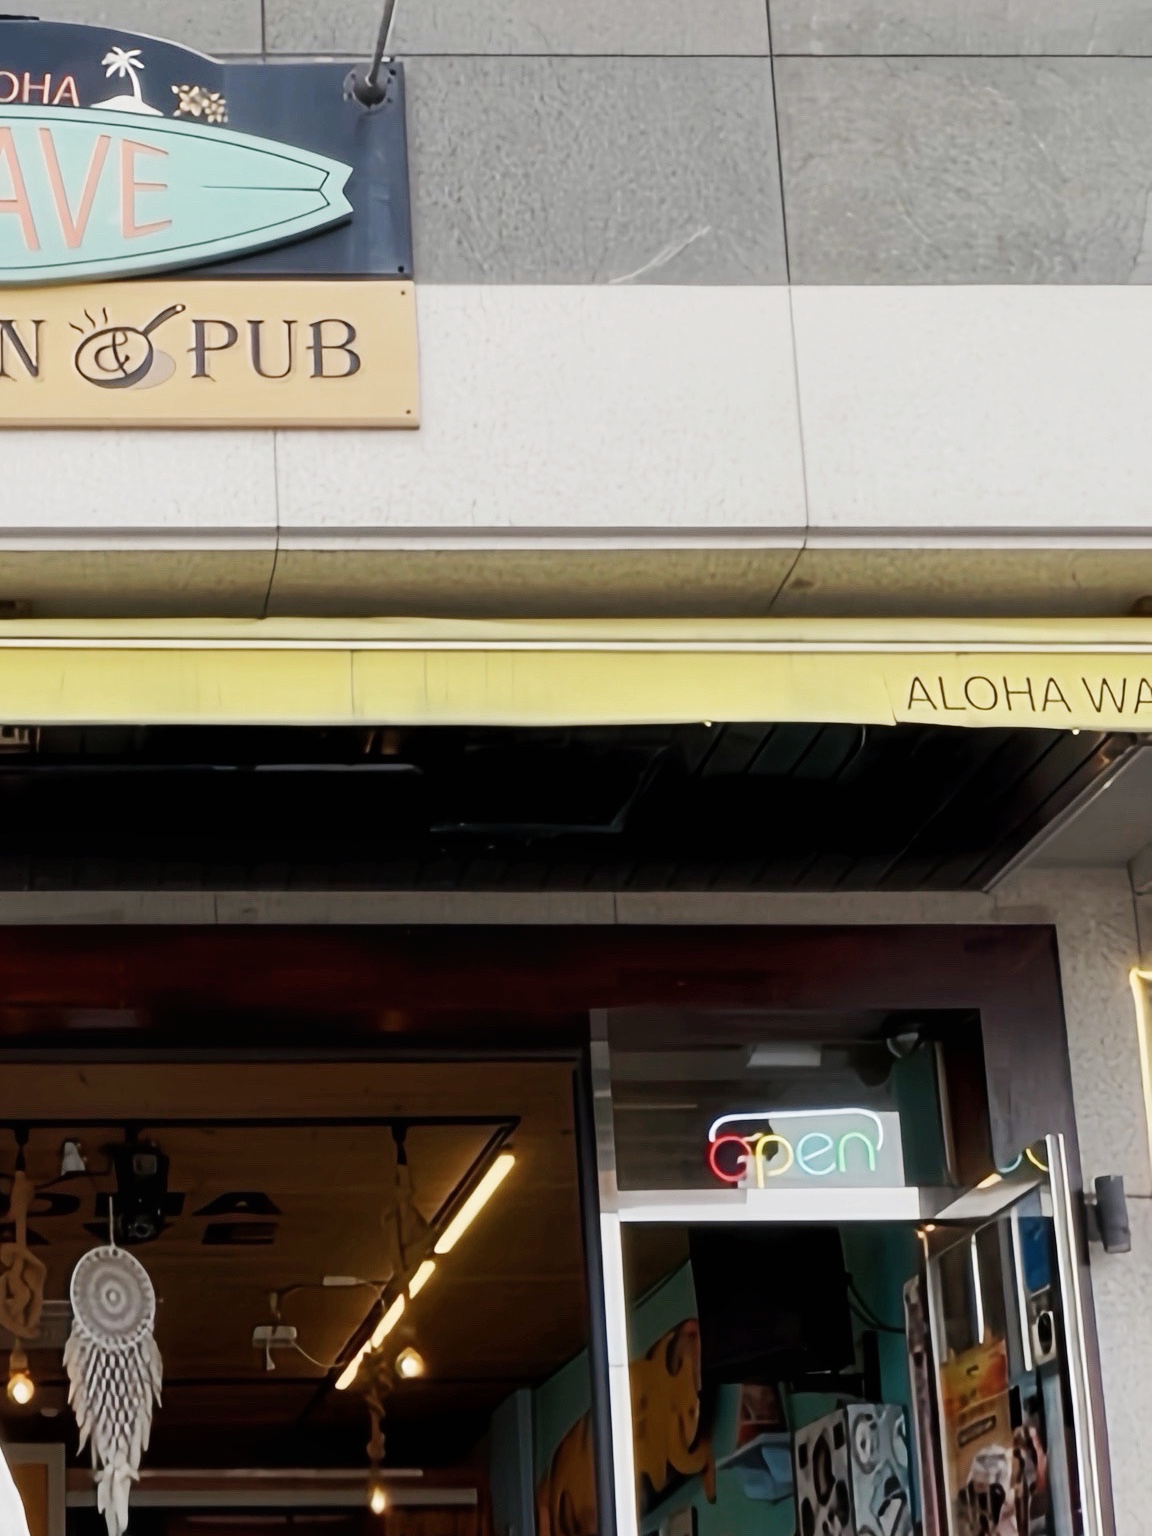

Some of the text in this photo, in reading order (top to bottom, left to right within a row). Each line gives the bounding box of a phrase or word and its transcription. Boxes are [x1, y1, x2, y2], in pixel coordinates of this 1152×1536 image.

[187, 318, 361, 382] PUB
[907, 676, 1072, 713] ALOHA
[708, 1131, 877, 1189] open
